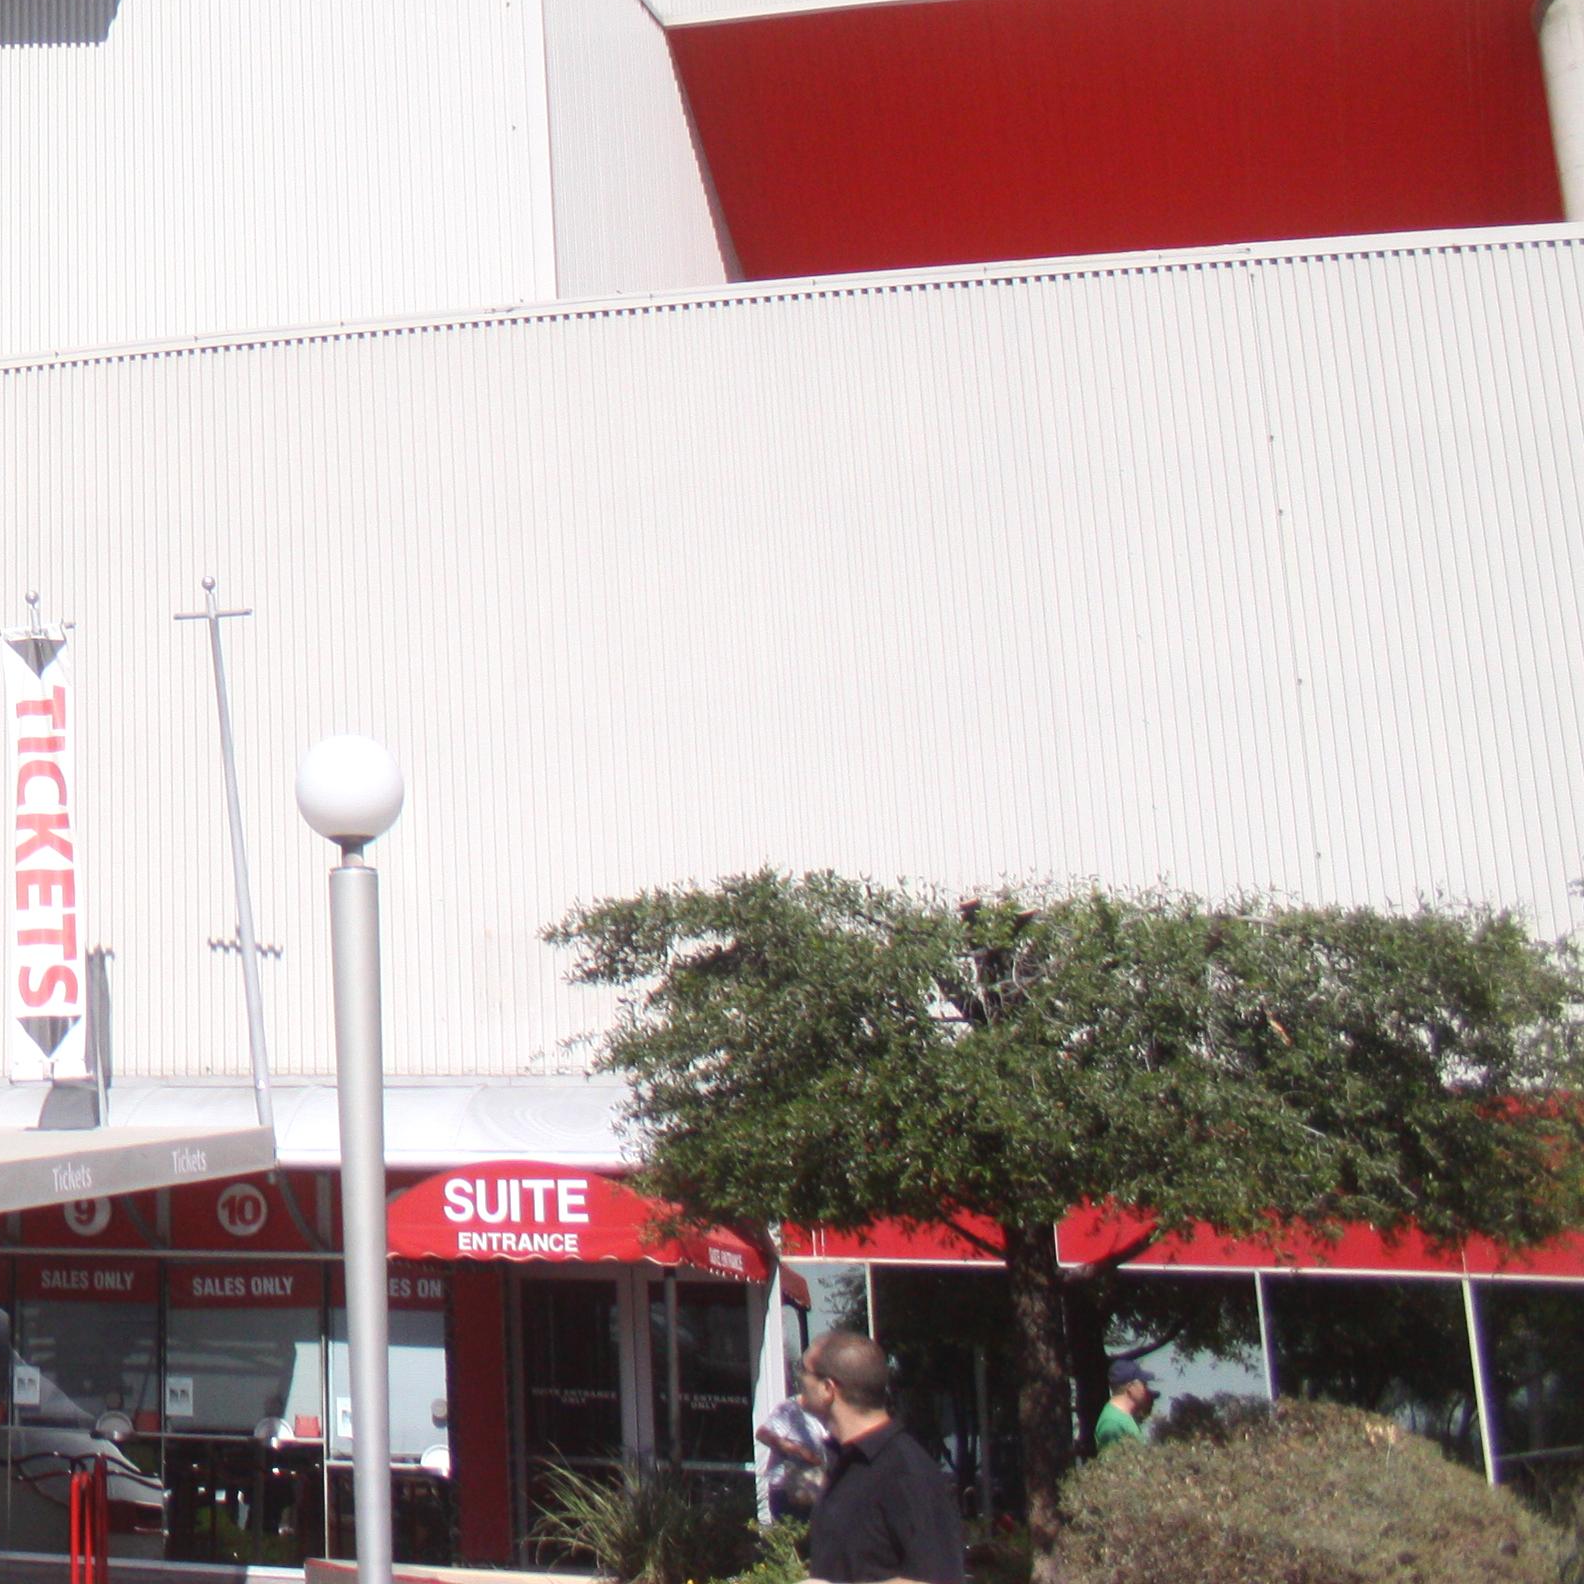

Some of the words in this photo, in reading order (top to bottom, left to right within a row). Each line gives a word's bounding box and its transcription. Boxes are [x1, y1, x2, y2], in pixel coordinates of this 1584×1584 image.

[16, 685, 79, 1008] TICKETS
[172, 1149, 208, 1175] Tickets
[52, 1162, 93, 1193] Tickets
[220, 1194, 263, 1227] 10
[443, 1178, 590, 1224] SUITE
[458, 1231, 579, 1253] ENTRANCE
[41, 1270, 88, 1289] SALES
[94, 1271, 134, 1291] ONLY
[193, 1277, 245, 1296] SALES
[251, 1275, 294, 1297] ONLY
